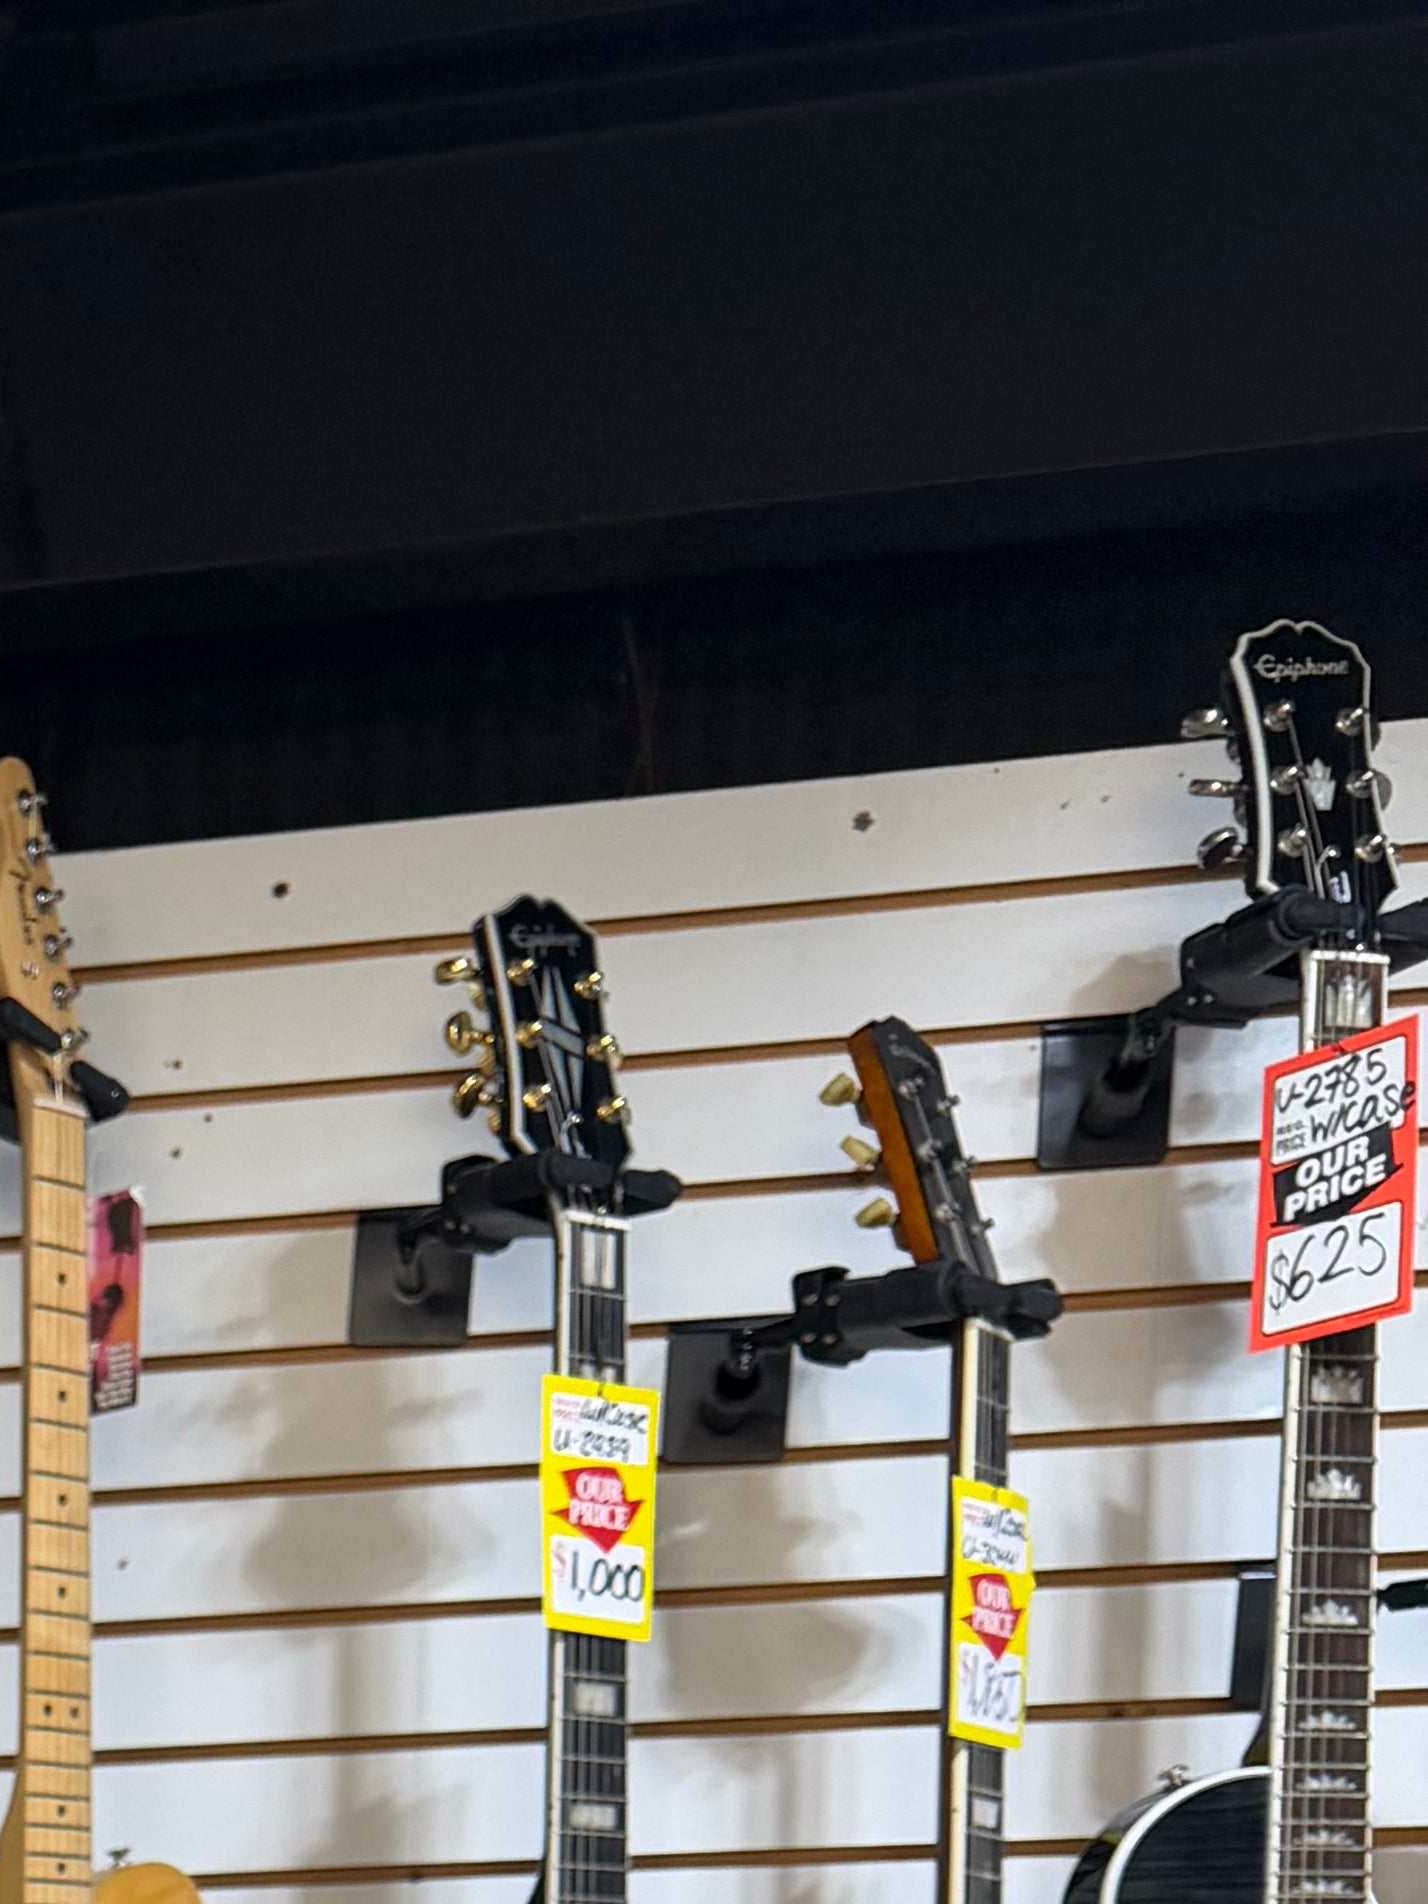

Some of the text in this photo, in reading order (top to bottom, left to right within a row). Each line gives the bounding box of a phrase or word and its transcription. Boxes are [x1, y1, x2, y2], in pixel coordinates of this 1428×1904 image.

[1252, 654, 1350, 683] Epiphone
[1277, 1047, 1388, 1114] U-2785
[1282, 1153, 1388, 1224] PRICE
[1295, 1134, 1371, 1191] OUR
[1269, 1212, 1388, 1316] $625
[568, 1498, 632, 1532] PRICE
[574, 1470, 626, 1505] OUR
